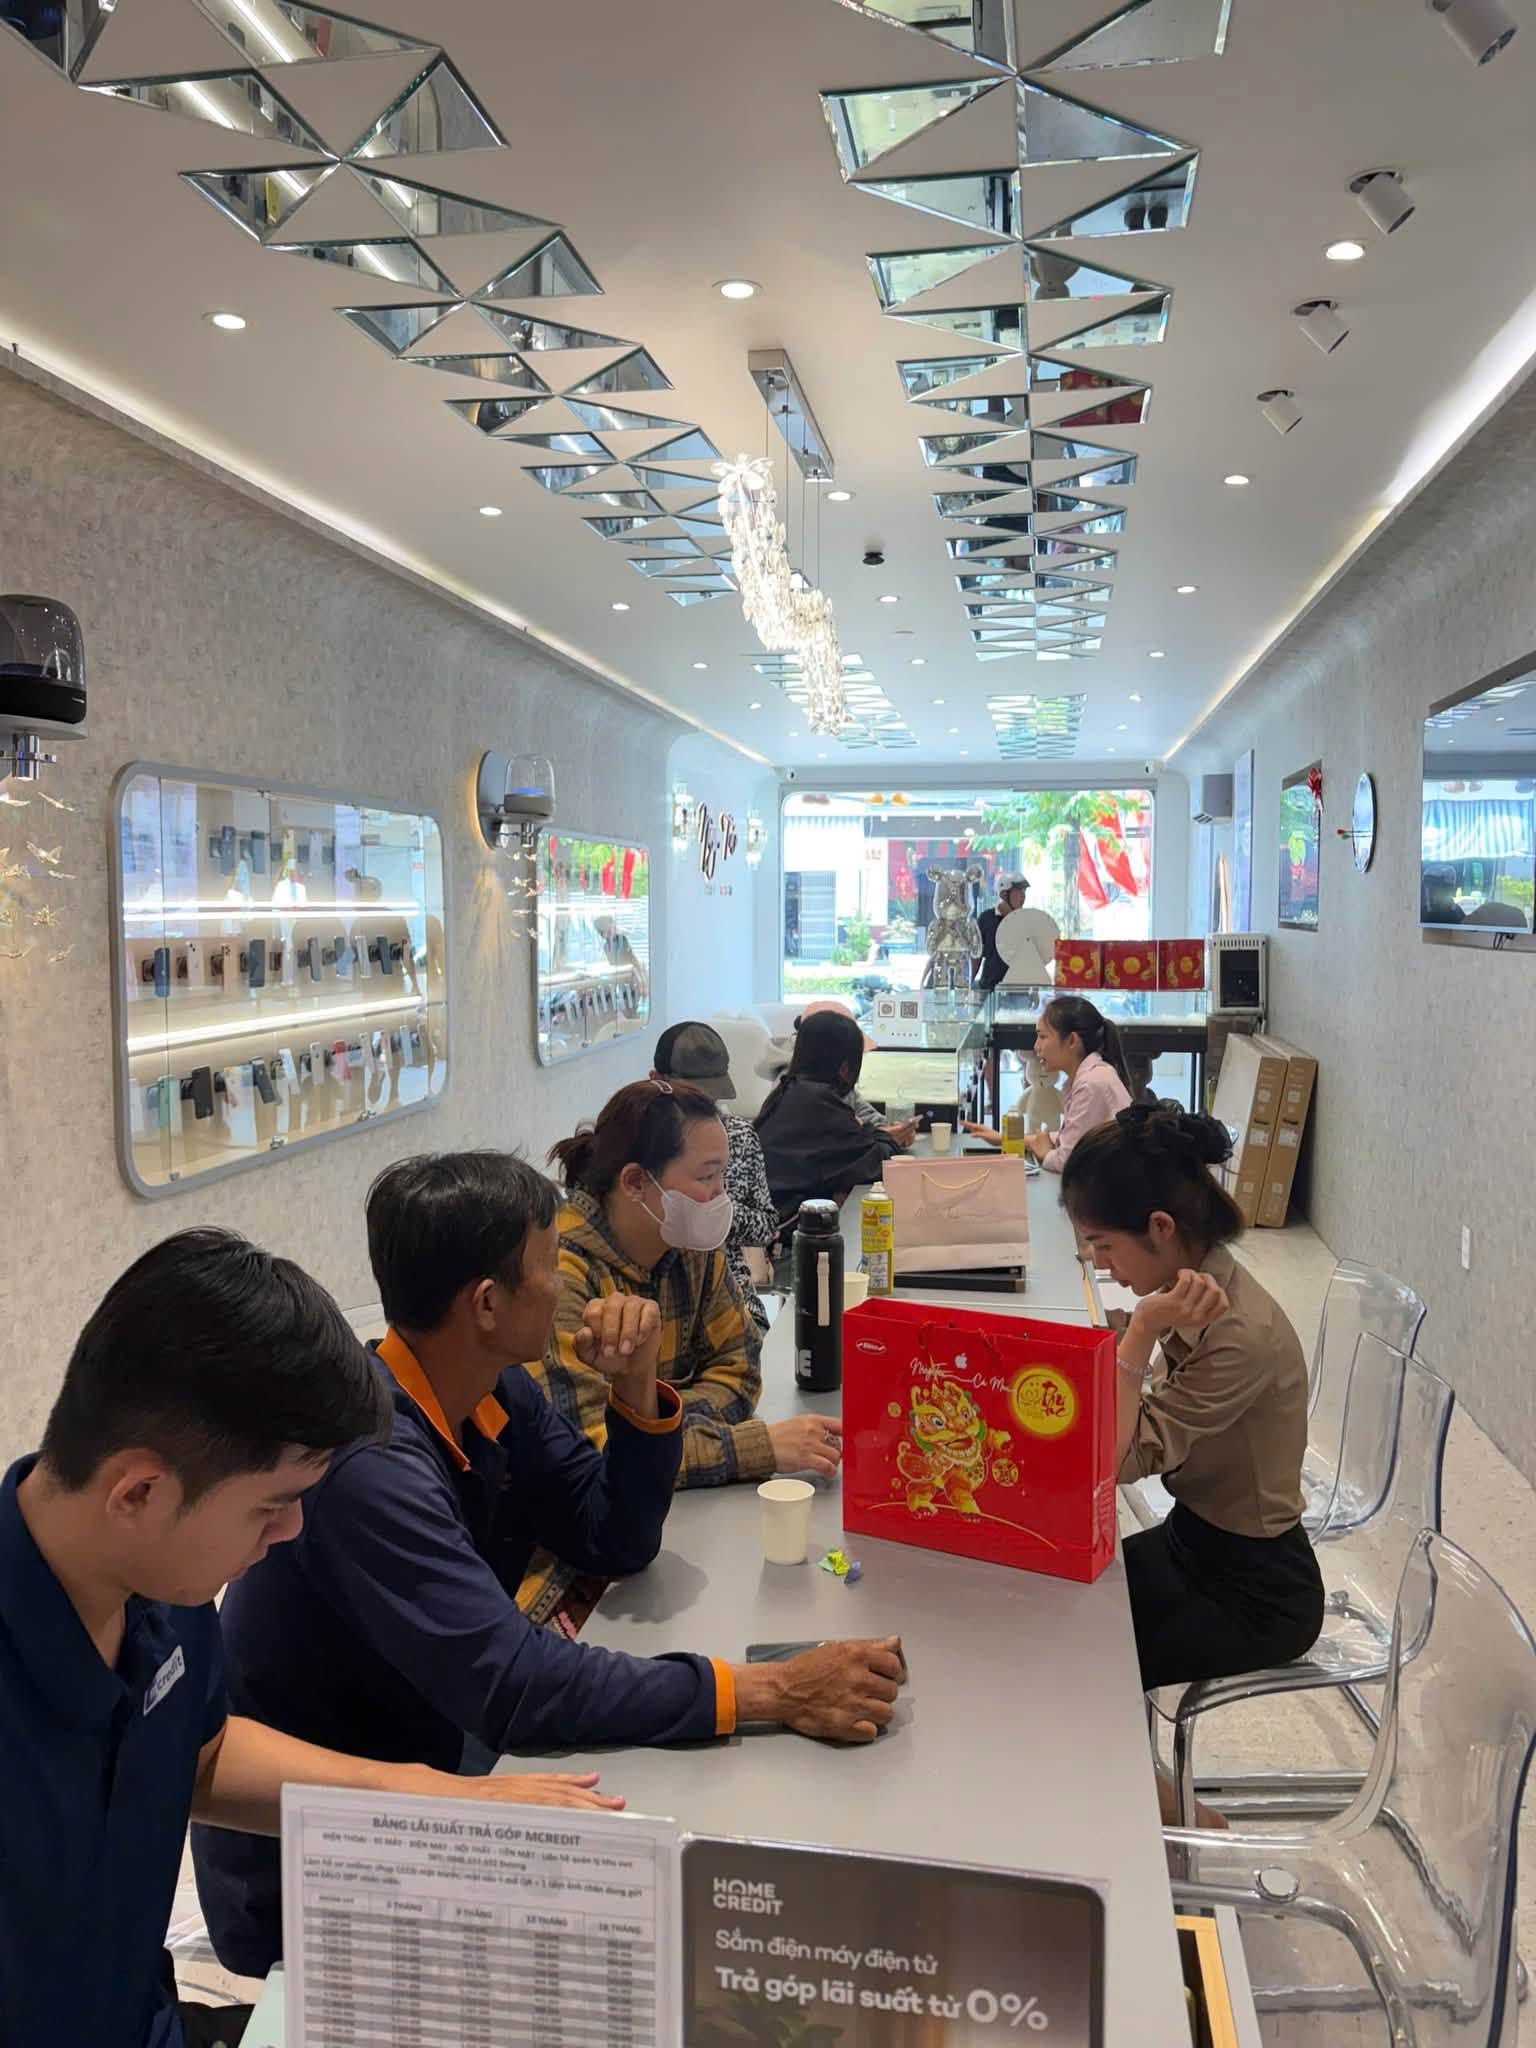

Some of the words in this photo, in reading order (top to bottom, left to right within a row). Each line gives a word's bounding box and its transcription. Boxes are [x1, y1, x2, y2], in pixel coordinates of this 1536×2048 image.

[373, 1813, 408, 1830] BẢNG
[411, 1819, 429, 1832] LÃI
[432, 1818, 464, 1835] SUẤT
[469, 1823, 491, 1838] TRẢ
[495, 1827, 521, 1841] GÓP
[525, 1832, 581, 1846] MCREDIT
[712, 1893, 783, 1915] CREDIT
[713, 1877, 776, 1898] HOME
[715, 1927, 764, 1952] Sắm
[767, 1936, 811, 1960] điện
[815, 1945, 861, 1971] máy
[864, 1948, 910, 1973] điện
[913, 1953, 938, 1975] tử
[715, 1966, 760, 1993] Trả
[765, 1973, 817, 2005] góp
[822, 1978, 854, 2005] lãi
[859, 1986, 924, 2015] suất
[928, 1994, 963, 2019] từ
[966, 1988, 1049, 2030] 0%
